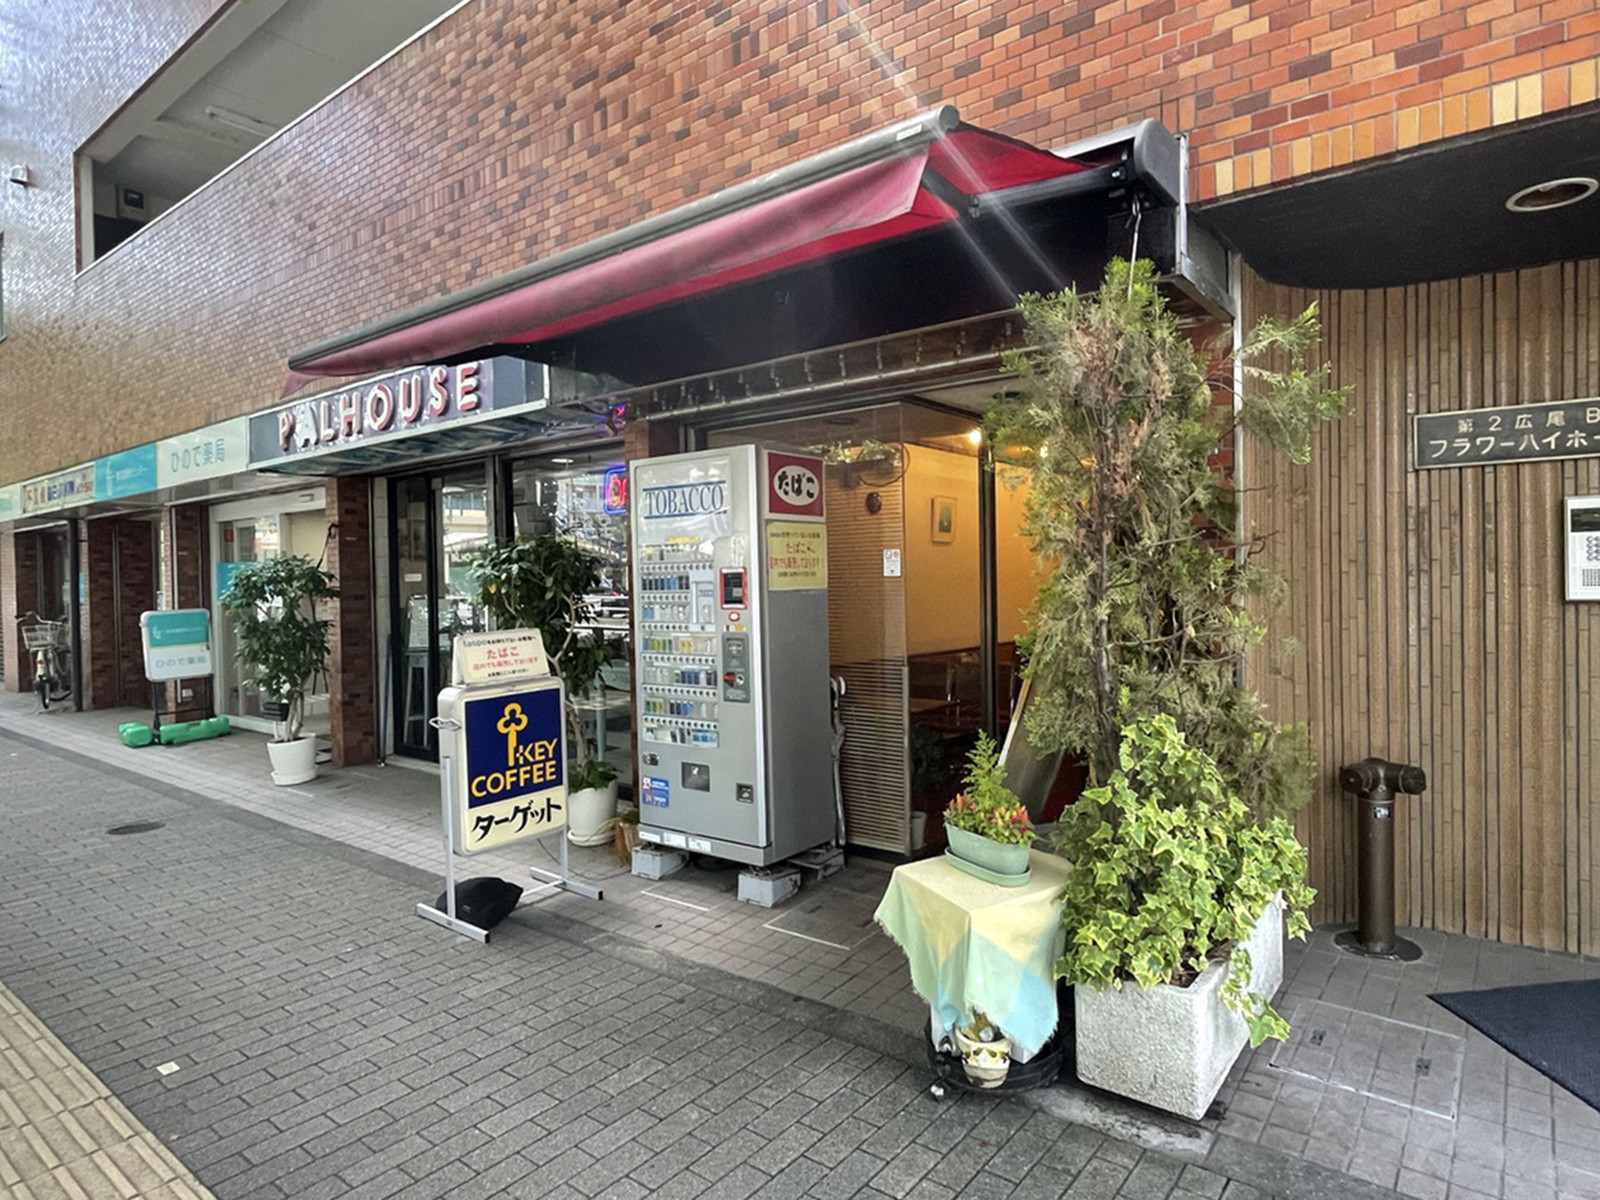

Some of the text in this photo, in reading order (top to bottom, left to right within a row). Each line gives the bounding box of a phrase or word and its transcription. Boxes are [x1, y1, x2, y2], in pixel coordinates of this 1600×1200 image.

[277, 361, 479, 451] PALHOUSE
[644, 484, 724, 515] TOBACCO
[778, 470, 814, 499] たばこ
[487, 646, 519, 660] たばこ
[516, 738, 559, 764] KEY
[471, 760, 557, 798] COFFEE
[471, 797, 563, 844] ターゲット
